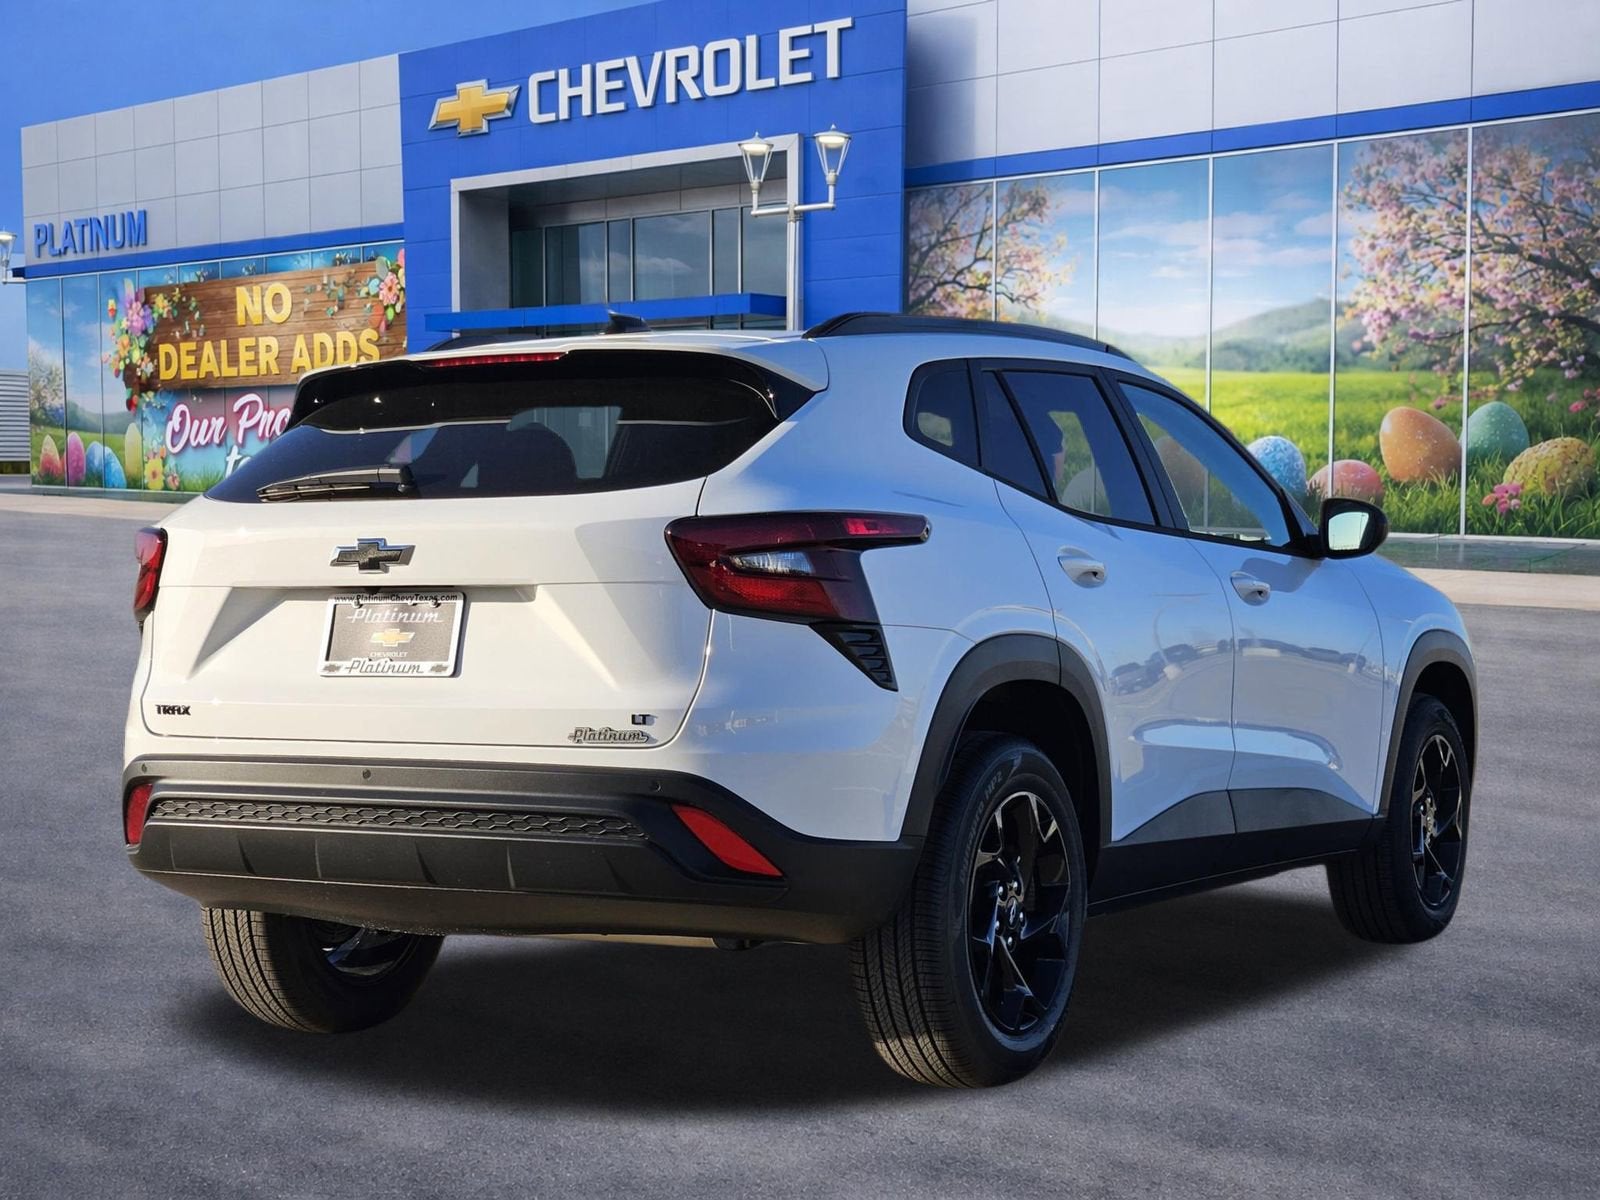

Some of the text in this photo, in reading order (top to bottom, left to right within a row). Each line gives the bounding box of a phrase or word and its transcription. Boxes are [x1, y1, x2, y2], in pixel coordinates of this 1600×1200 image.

[528, 16, 854, 125] CHEVROLET
[34, 209, 148, 258] PLATINUM
[235, 282, 293, 327] NO
[158, 327, 381, 381] DEALER ADDS
[165, 403, 228, 454] Our
[347, 607, 443, 624] Platinum
[345, 659, 424, 674] Platinum
[155, 704, 191, 716] TRAX
[631, 714, 650, 725] LT
[567, 727, 650, 744] Platinum
